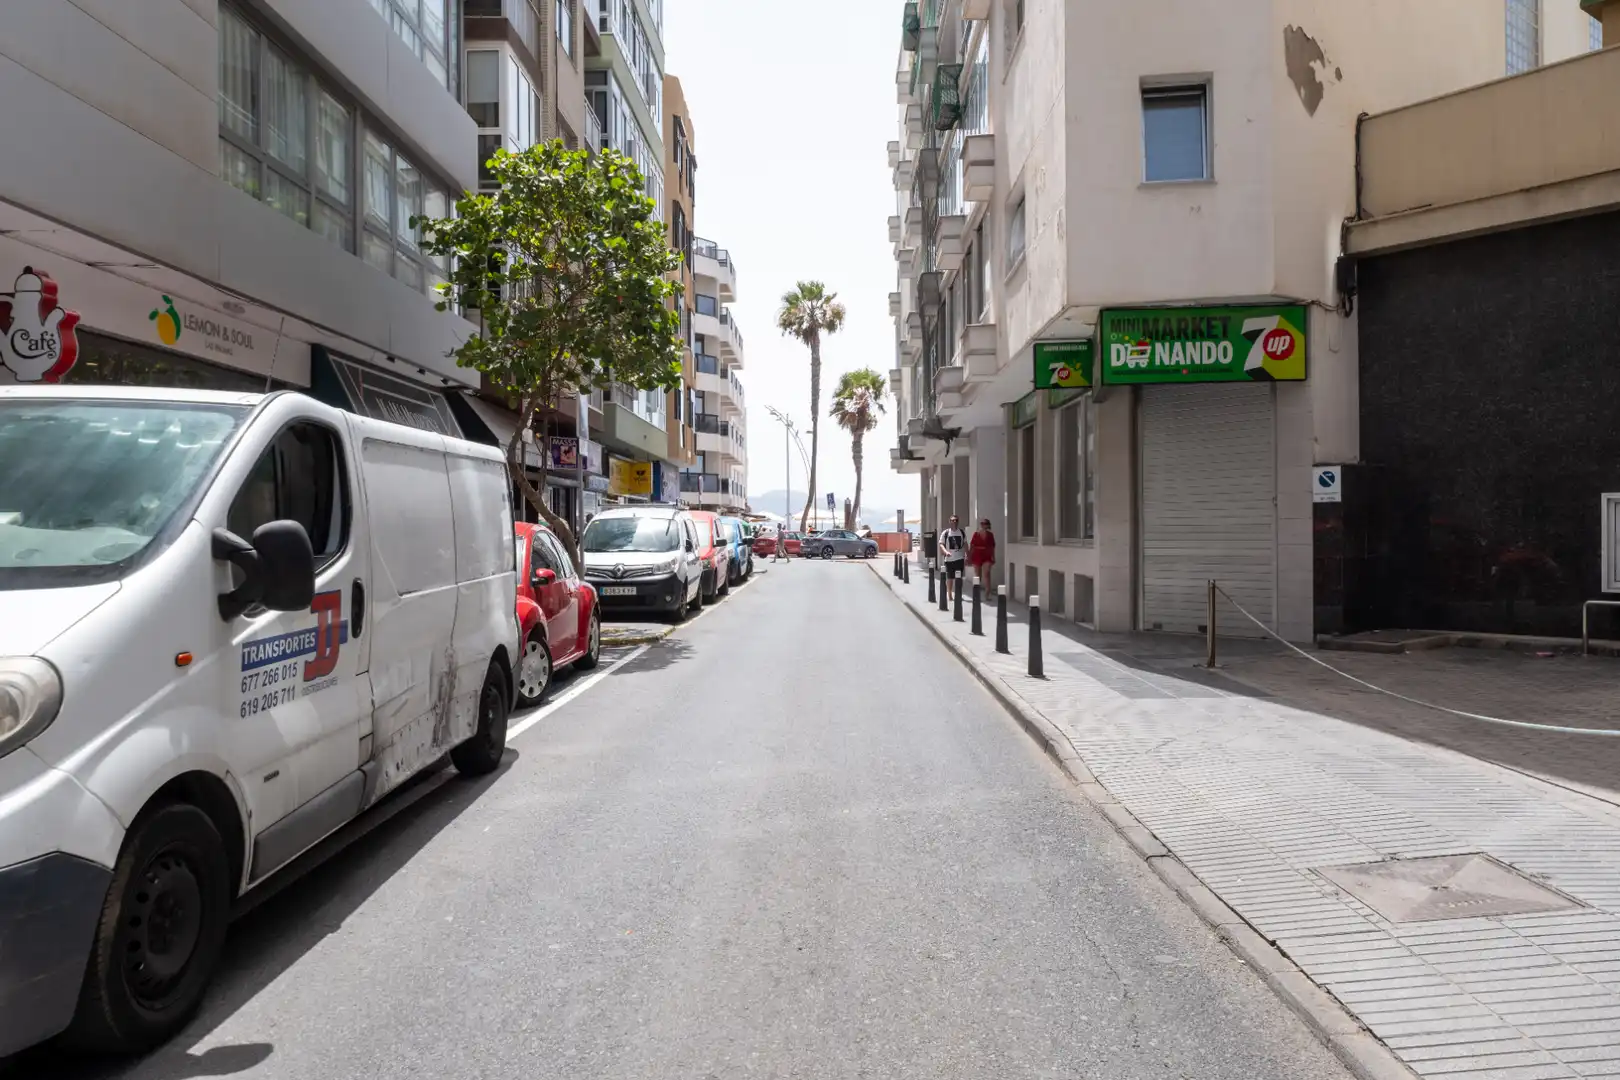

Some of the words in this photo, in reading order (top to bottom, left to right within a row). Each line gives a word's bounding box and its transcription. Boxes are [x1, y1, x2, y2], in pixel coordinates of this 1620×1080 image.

[183, 312, 220, 338] LEMON
[222, 326, 230, 341] &
[231, 328, 254, 350] SOUL
[1110, 317, 1139, 333] MINI
[1141, 315, 1231, 340] MARKET
[10, 328, 57, 360] Café
[242, 632, 316, 665] TRANSPORTES
[241, 672, 260, 694] 677
[262, 667, 279, 688] 266
[281, 662, 298, 681] 015
[240, 698, 259, 719] 619
[261, 691, 279, 712] 205
[281, 685, 296, 705] 711
